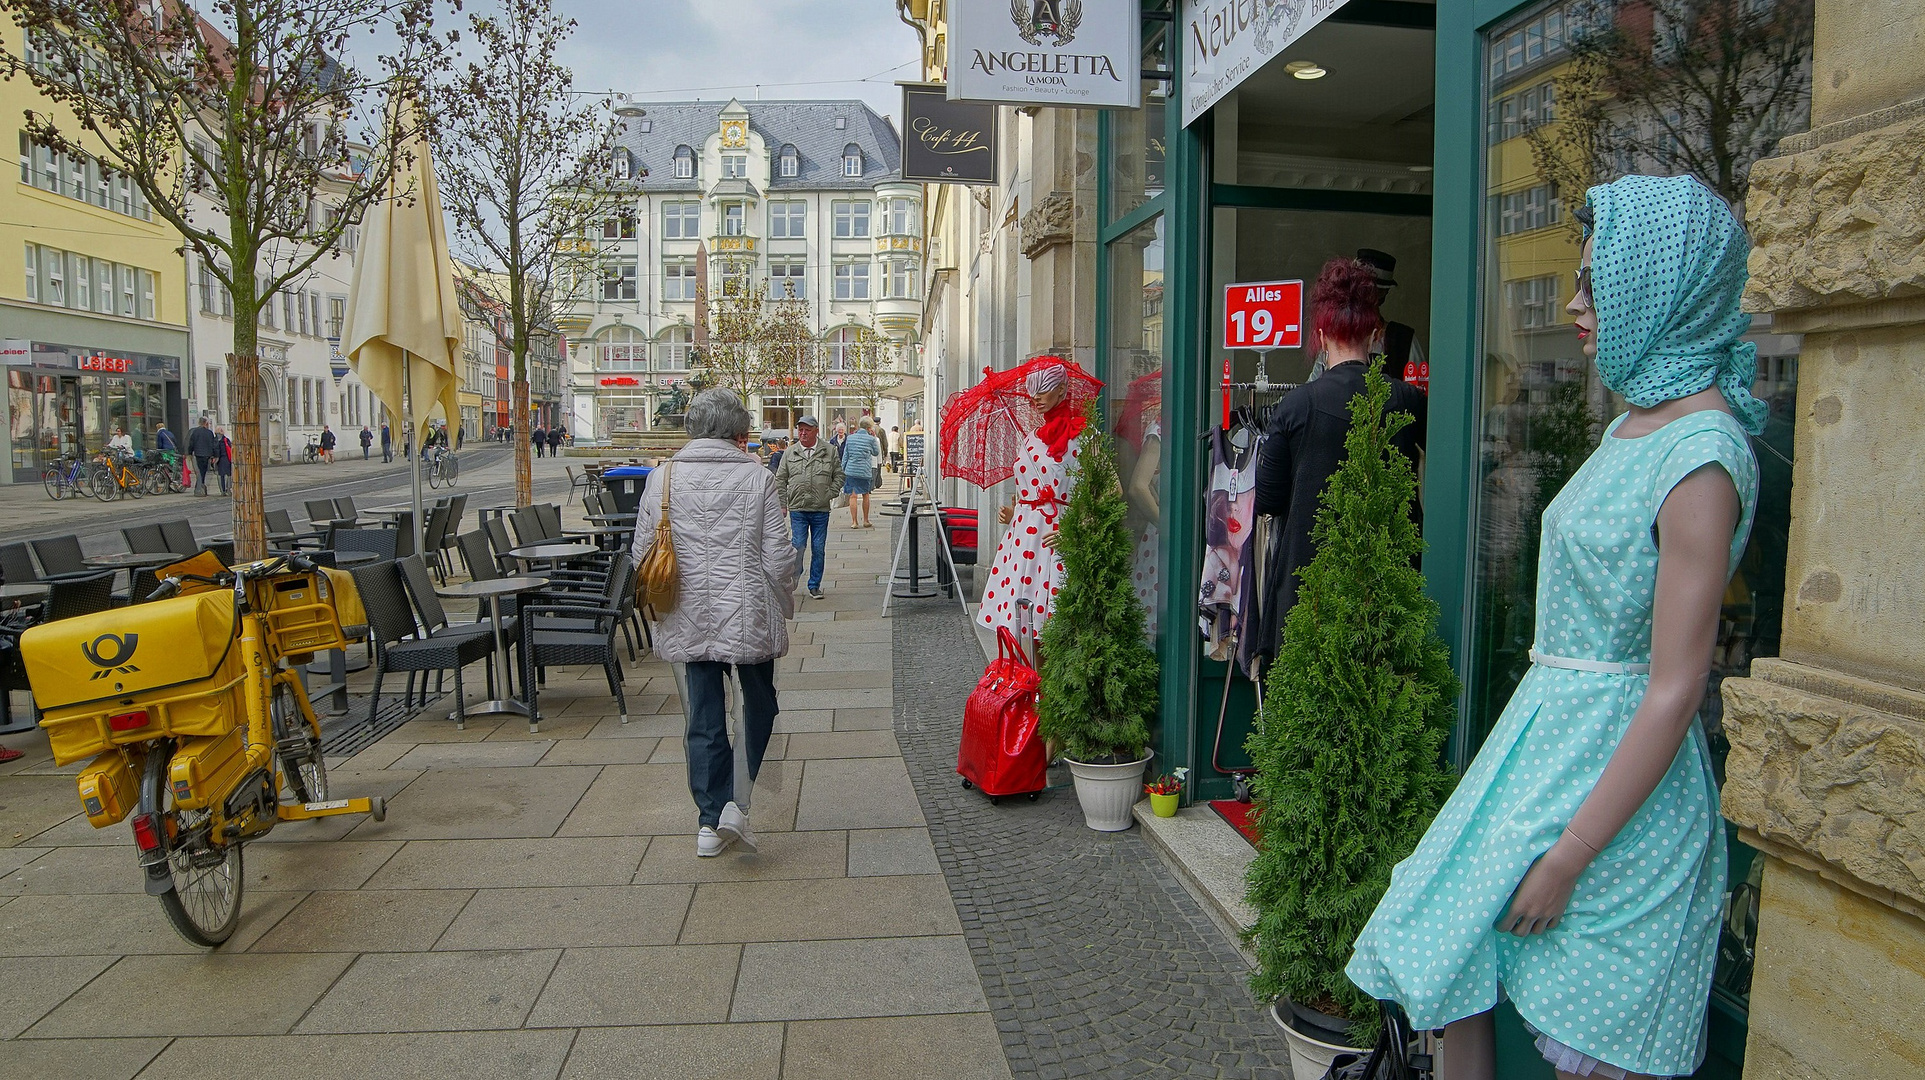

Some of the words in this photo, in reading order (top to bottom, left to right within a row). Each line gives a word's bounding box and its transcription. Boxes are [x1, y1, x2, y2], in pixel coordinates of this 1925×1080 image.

[1191, 0, 1275, 78] Neuer
[970, 49, 1122, 82] ANGELETTA
[1036, 75, 1067, 87] MODA
[1002, 85, 1028, 93] Fashion
[1034, 86, 1059, 95] Beauty
[1065, 88, 1090, 96] Lounge
[1190, 75, 1225, 114] Königlicher
[1225, 56, 1251, 86] Service
[912, 116, 952, 150] Café
[952, 130, 981, 148] 44
[1245, 287, 1282, 303] Alles
[1230, 309, 1298, 346] 19,-
[0, 348, 28, 356] Leiser
[77, 351, 134, 373] Leiser
[258, 690, 267, 730] Deutsche
